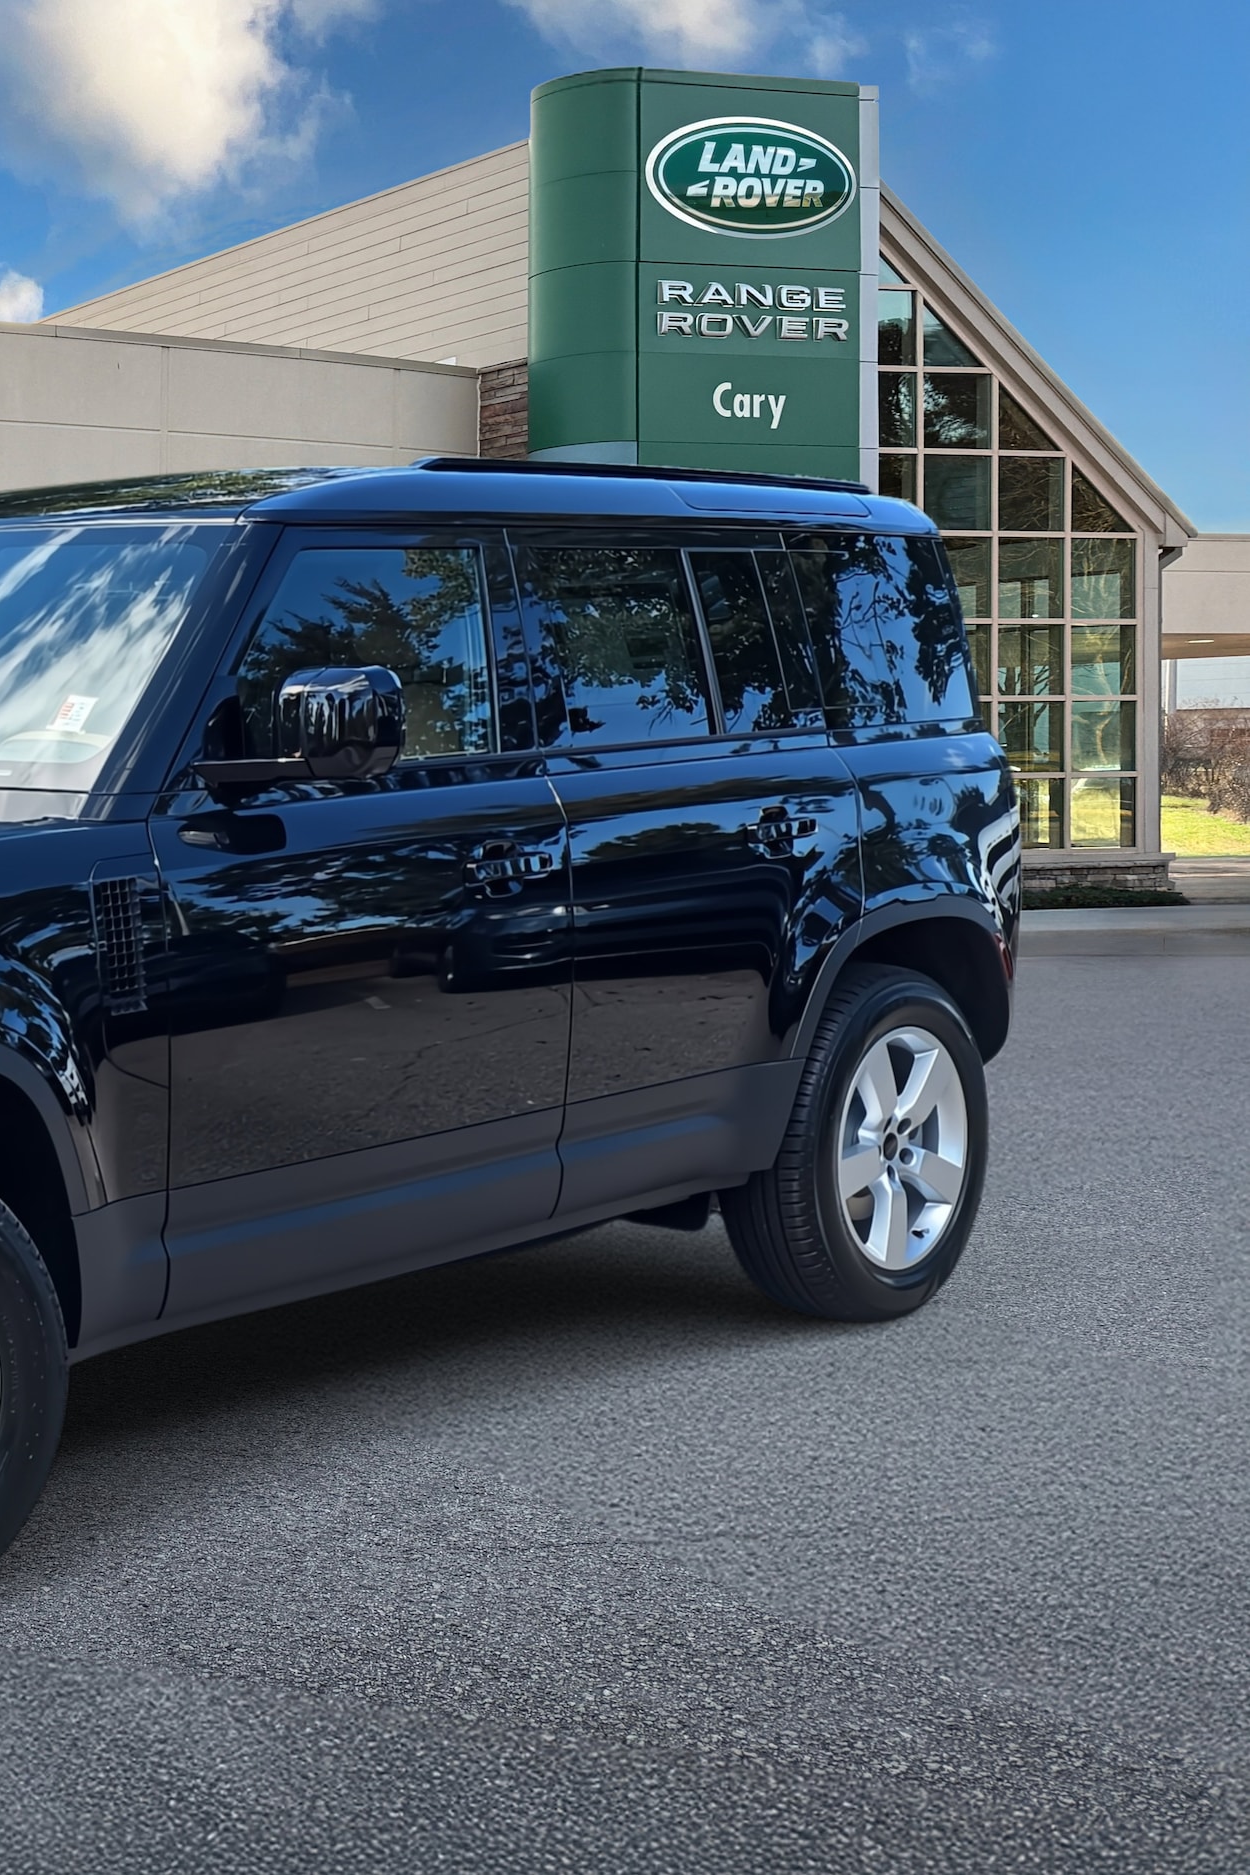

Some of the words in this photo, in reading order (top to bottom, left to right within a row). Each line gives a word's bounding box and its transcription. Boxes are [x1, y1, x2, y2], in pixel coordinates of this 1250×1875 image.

[697, 141, 796, 175] LAND
[710, 176, 825, 208] ROVER
[657, 280, 846, 312] RANGE
[657, 311, 849, 343] ROVER
[712, 382, 787, 429] Cary
